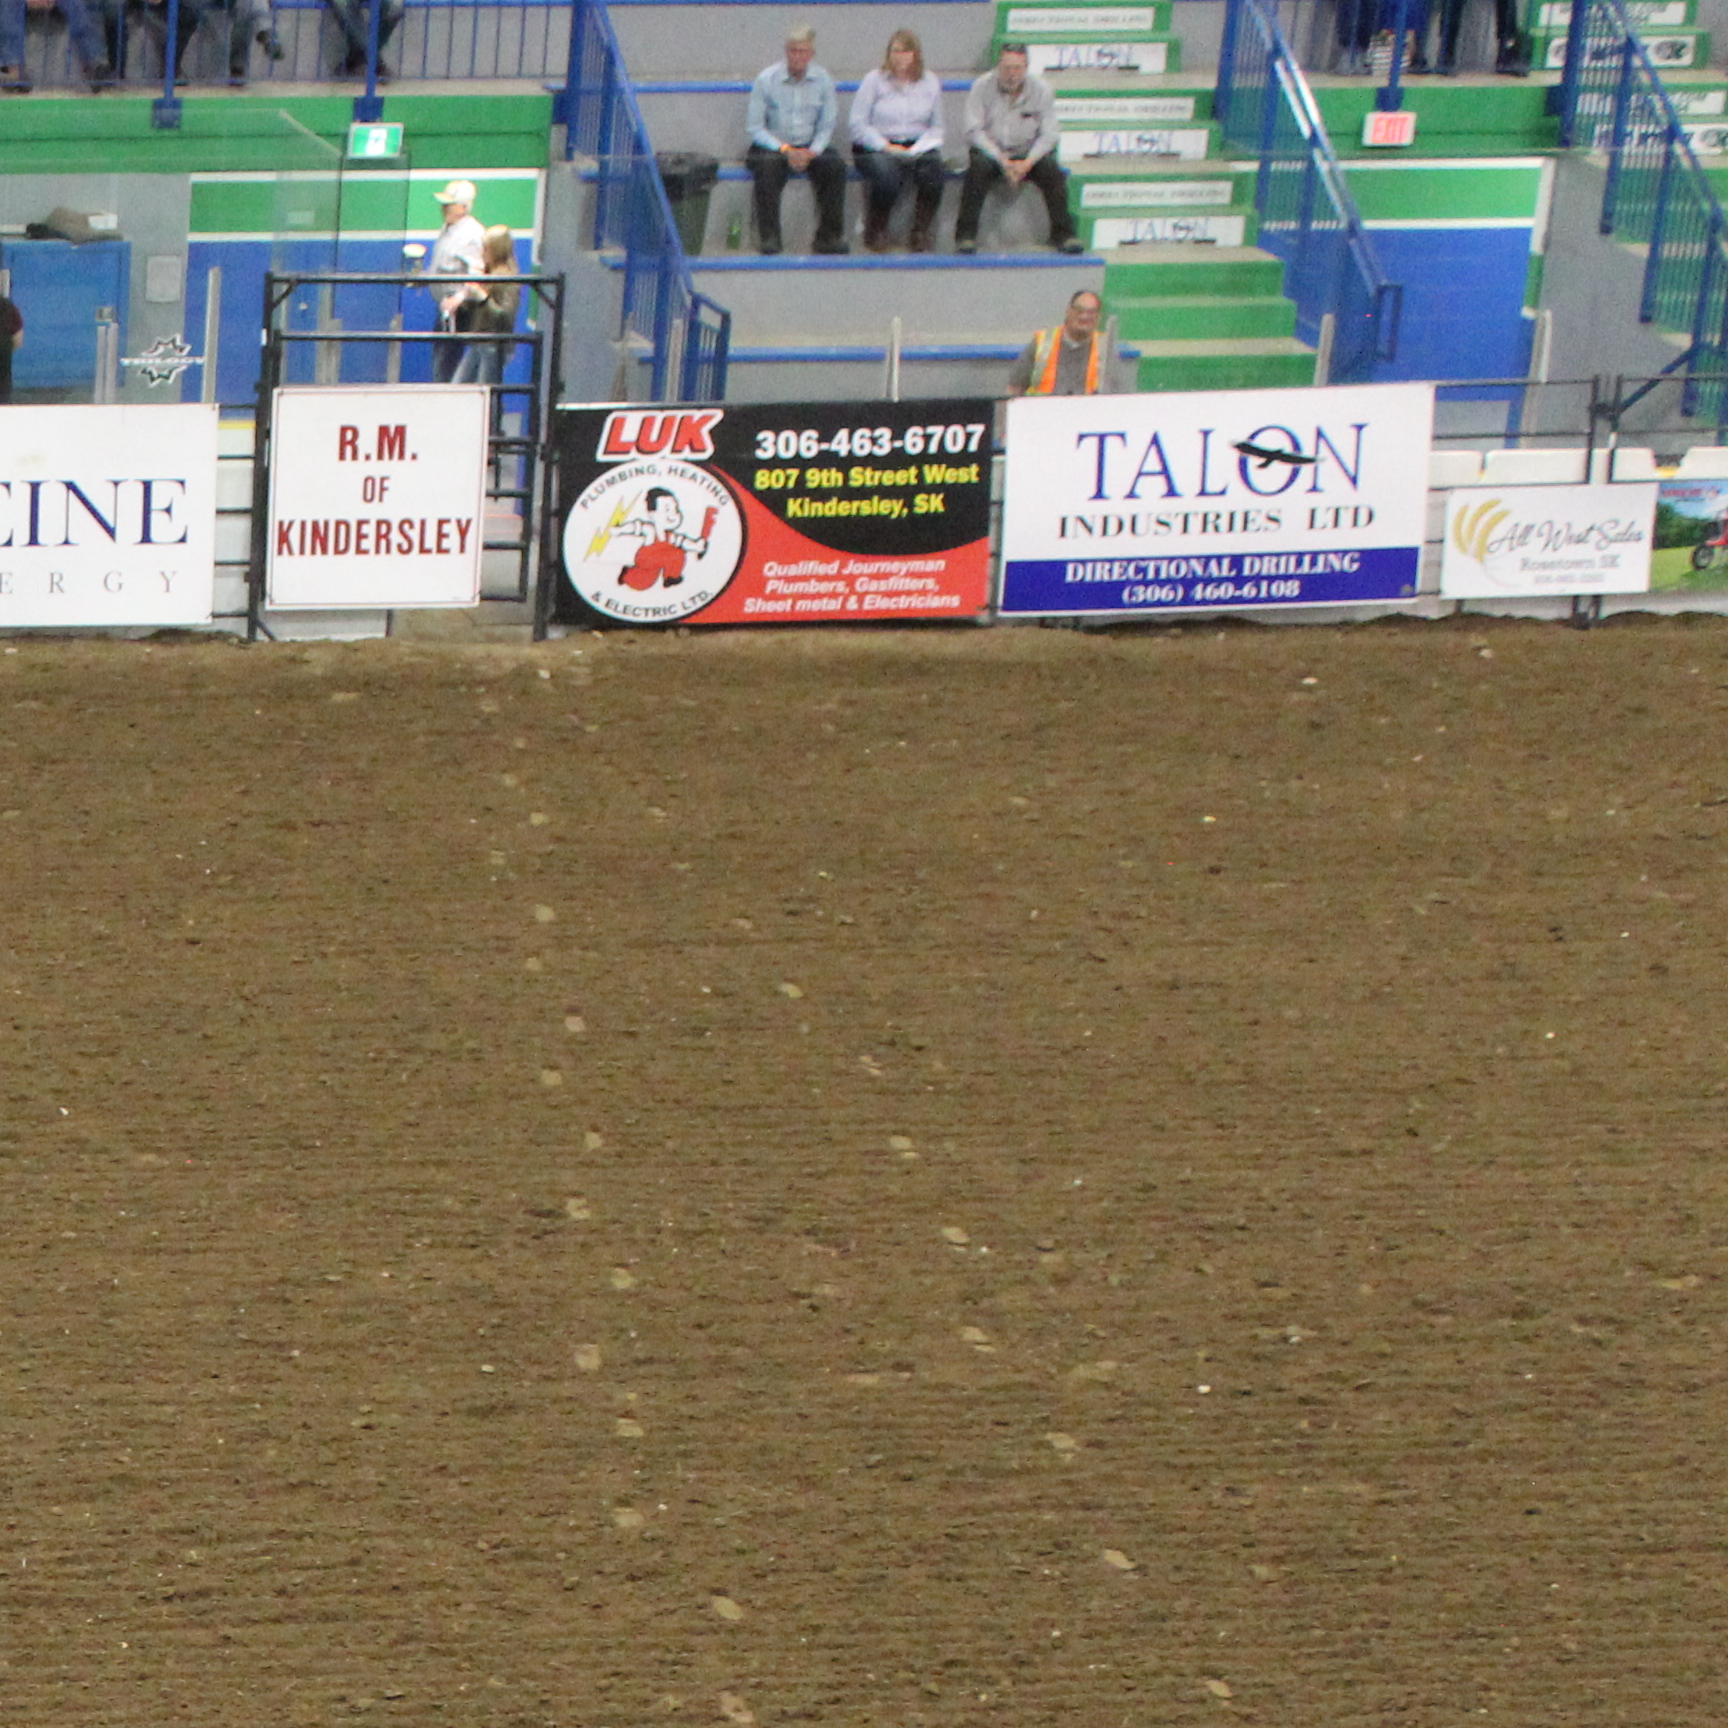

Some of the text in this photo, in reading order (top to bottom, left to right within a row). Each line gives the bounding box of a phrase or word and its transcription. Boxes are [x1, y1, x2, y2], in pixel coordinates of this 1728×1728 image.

[338, 424, 418, 462] R.M.
[599, 411, 721, 459] LUK
[754, 424, 985, 460] 306-463-6707
[754, 462, 980, 490] 807 9th Street West
[1076, 421, 1369, 501] TALON
[362, 475, 390, 503] OF
[580, 464, 731, 509] PLUMBING, HEATING
[786, 493, 946, 519] Kindersley, SK
[1058, 505, 1376, 539] INDUSTRIES LTD
[276, 517, 473, 556] KINDERSLEY
[1488, 517, 1645, 553] All West Sales
[763, 559, 946, 577] Qualified Journeyman
[1064, 551, 1360, 583] DIRECTIONAL DRILLING
[765, 576, 940, 595] Plumbers, Gasfitters,
[1122, 579, 1301, 604] (306) 460-6108
[591, 590, 600, 602] &
[604, 599, 678, 618] ELECTRIC
[744, 593, 961, 613] Sheet metal & Electricians
